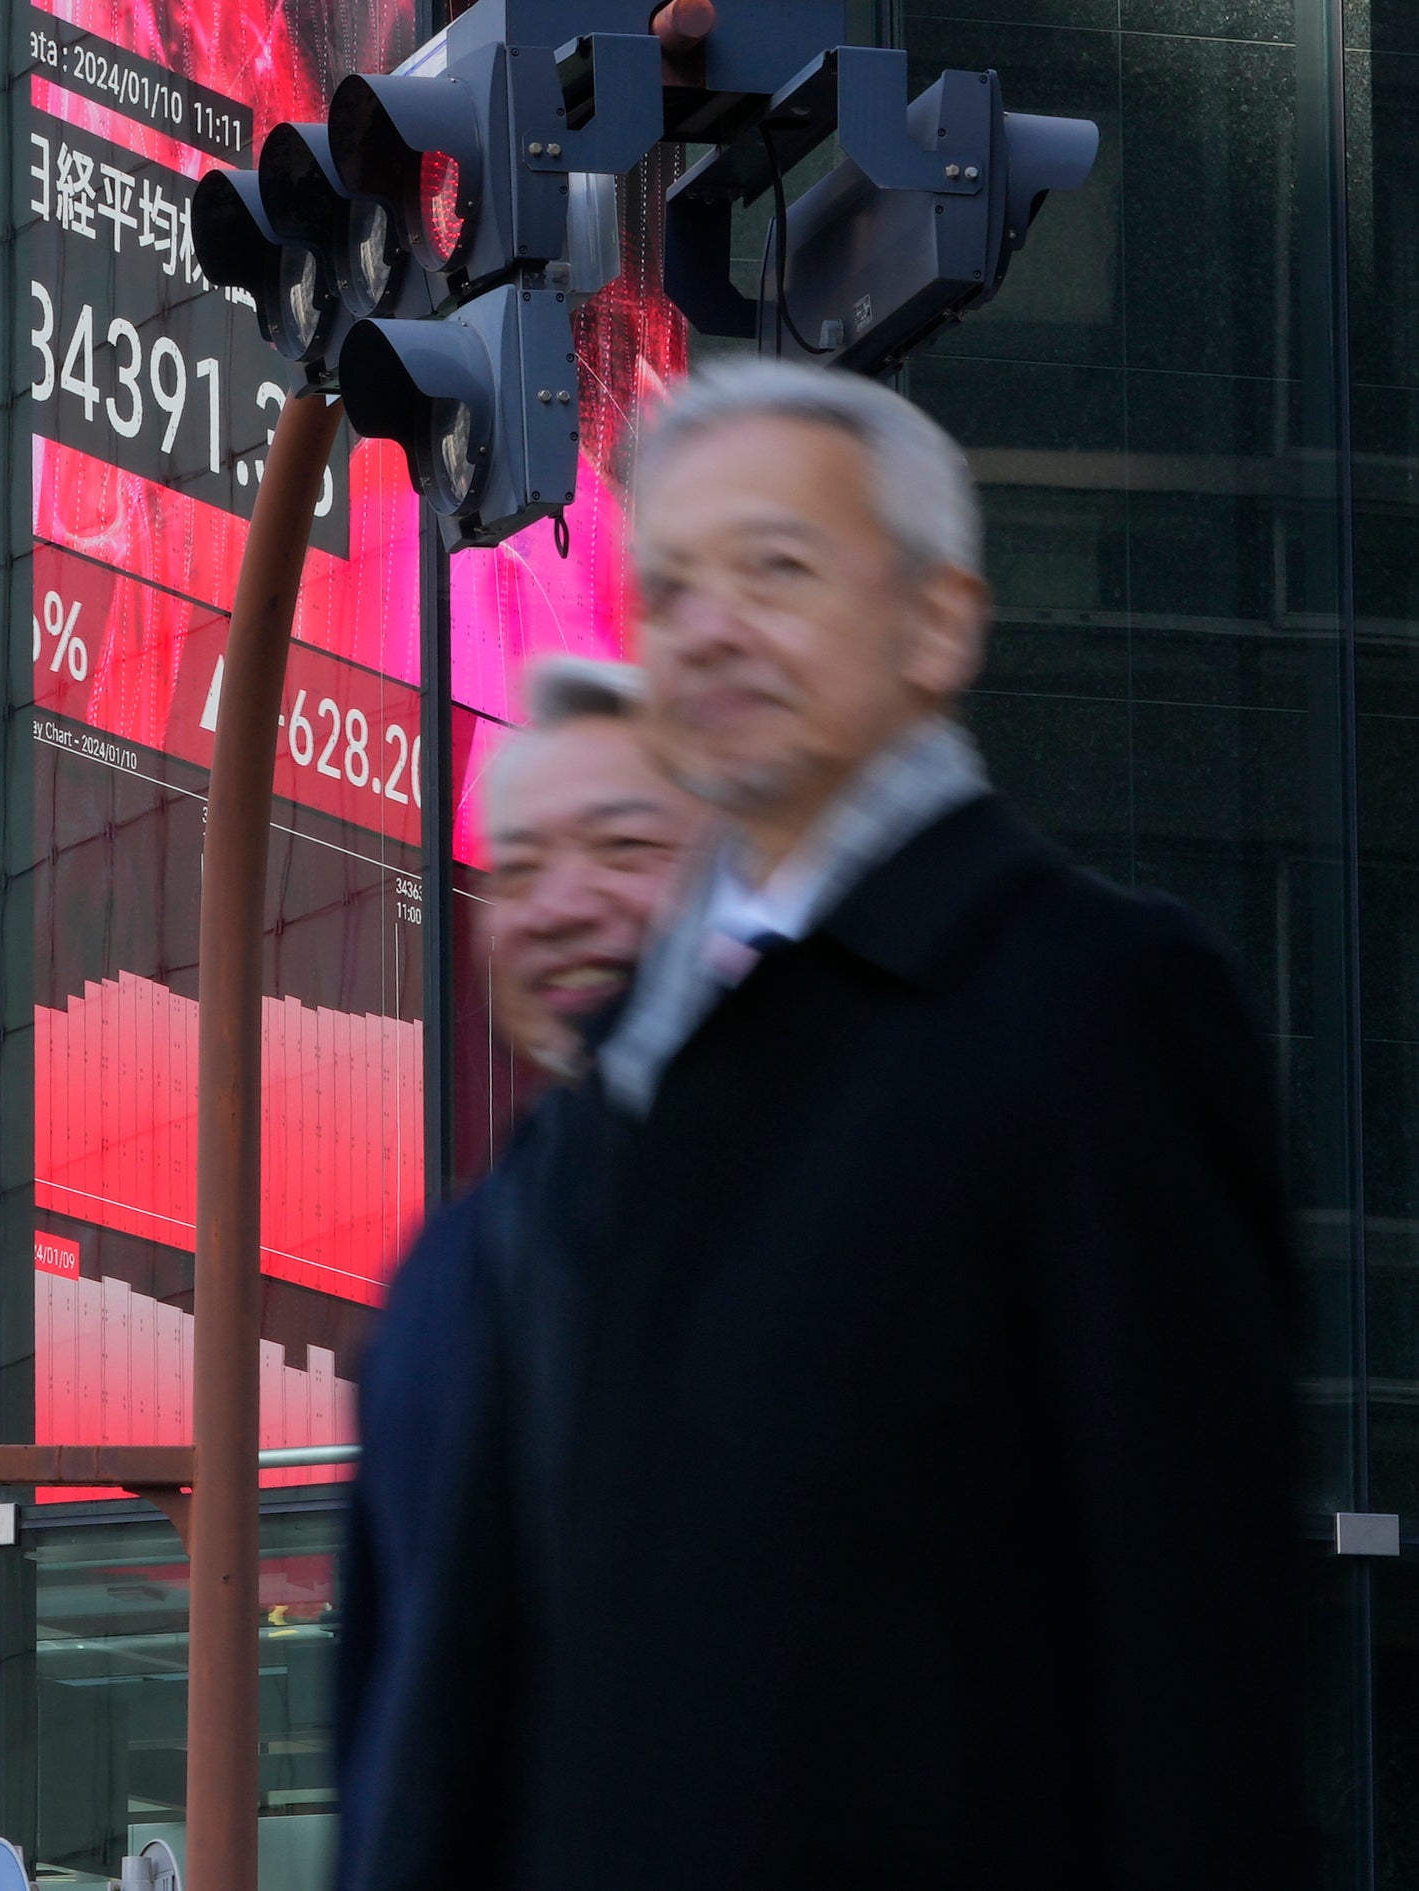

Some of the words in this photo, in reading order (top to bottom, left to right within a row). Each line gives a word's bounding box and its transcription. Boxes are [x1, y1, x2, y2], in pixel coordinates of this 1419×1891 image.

[62, 47, 68, 72] :
[74, 46, 182, 124] 2024/01/10
[194, 103, 241, 151] 11:11
[31, 132, 257, 313] 日経平均
[31, 280, 333, 518] 34391.
[45, 722, 73, 747] Chart
[81, 734, 137, 770] 2024/01/10
[278, 689, 422, 809] 628.2
[397, 901, 422, 925] 11:00
[34, 1243, 75, 1270] 4/01/09
